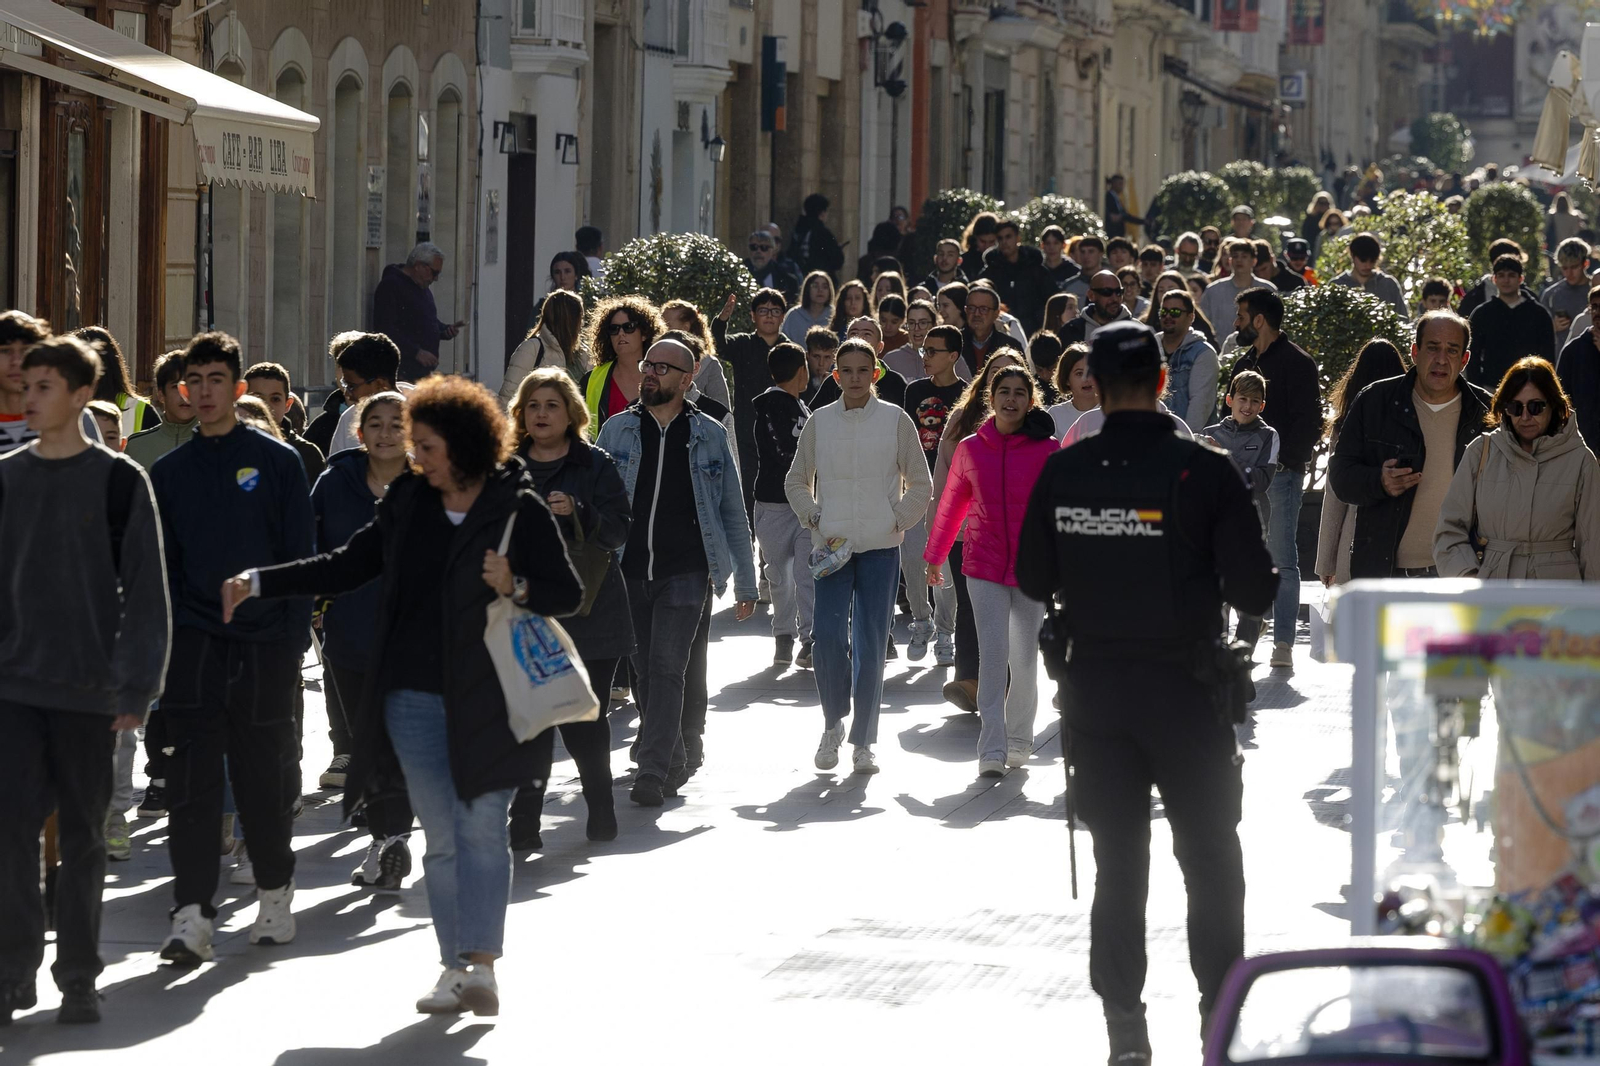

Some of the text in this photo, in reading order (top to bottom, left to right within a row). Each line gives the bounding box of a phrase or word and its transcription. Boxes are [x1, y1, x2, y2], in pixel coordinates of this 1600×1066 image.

[248, 135, 263, 174] BAR
[1054, 506, 1140, 523] POLICIA
[1056, 520, 1163, 537] NACIONAL
